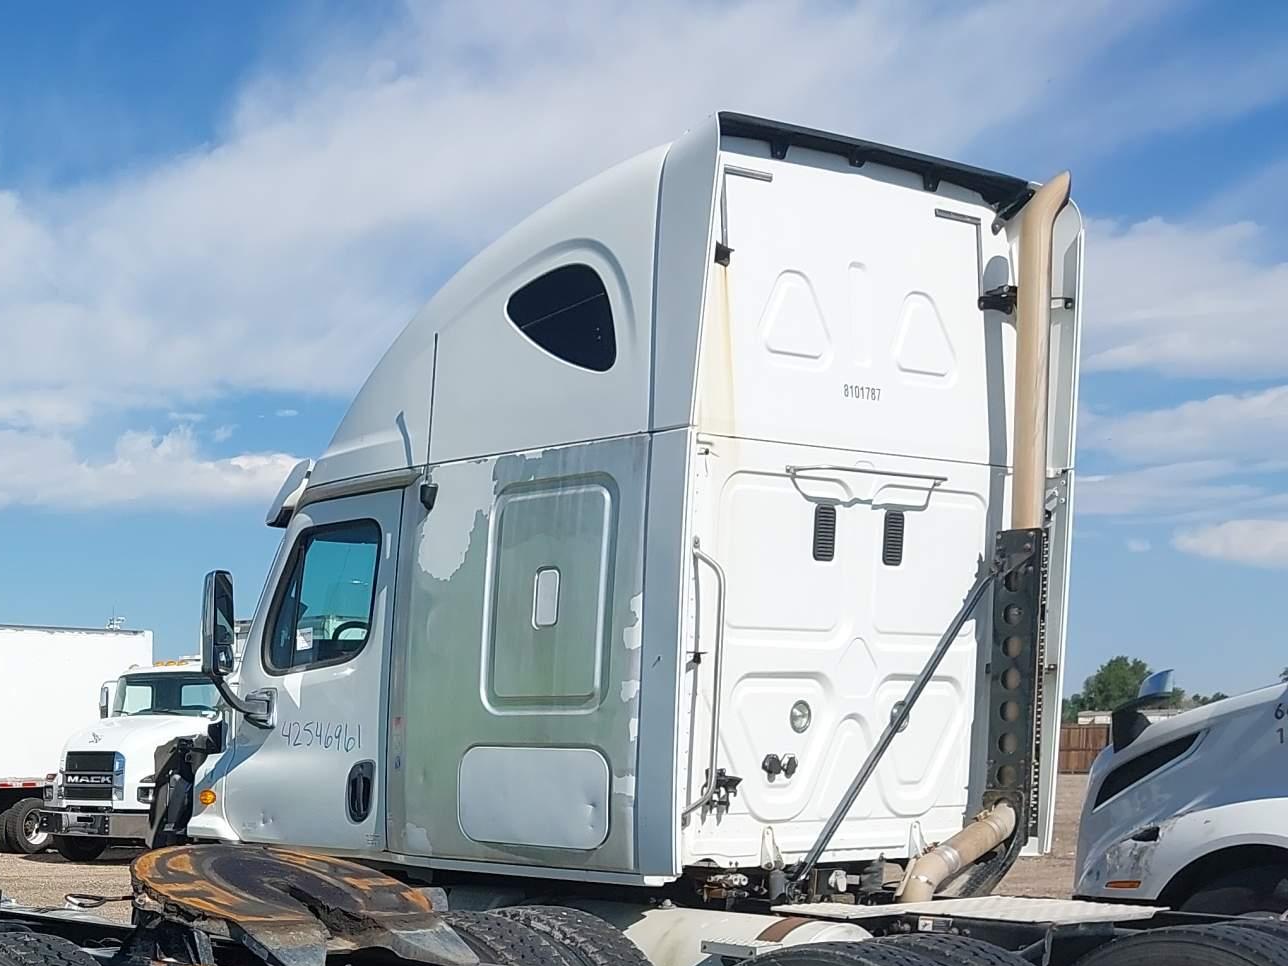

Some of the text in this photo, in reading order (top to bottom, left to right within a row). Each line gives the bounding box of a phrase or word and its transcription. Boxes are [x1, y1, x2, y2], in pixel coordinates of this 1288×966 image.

[843, 383, 881, 401] 8101787
[1274, 703, 1288, 720] 6
[281, 721, 361, 752] 42546961
[67, 775, 112, 784] MACK
